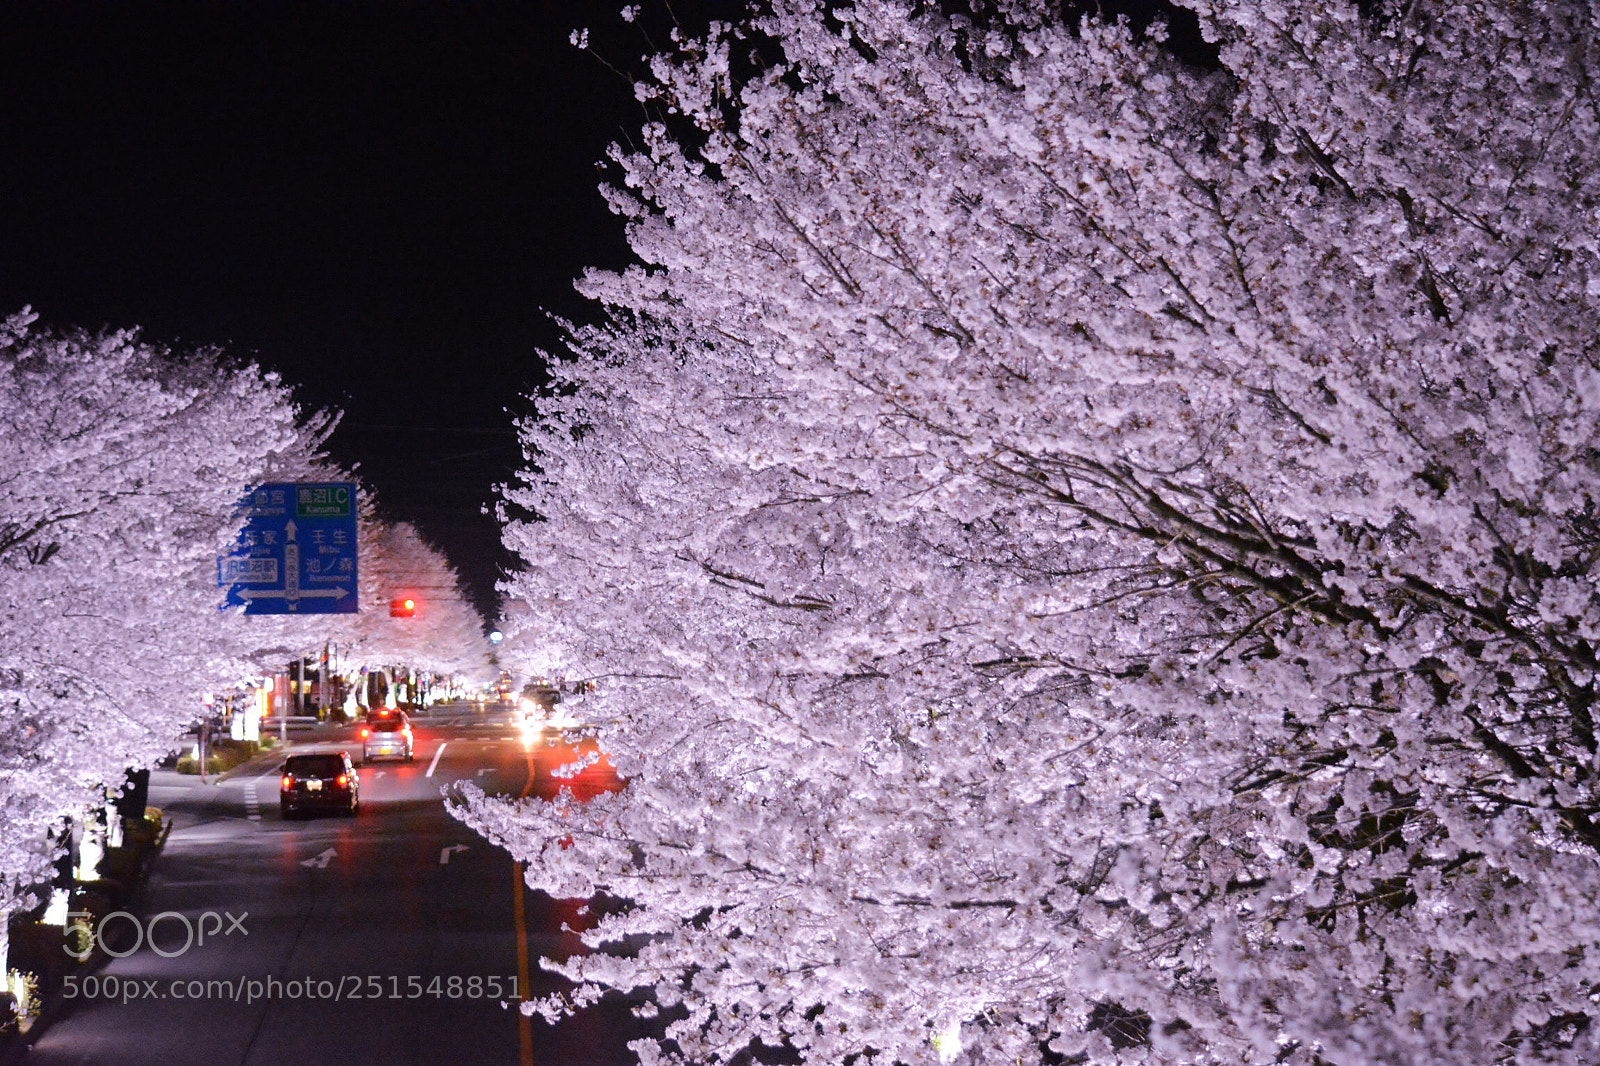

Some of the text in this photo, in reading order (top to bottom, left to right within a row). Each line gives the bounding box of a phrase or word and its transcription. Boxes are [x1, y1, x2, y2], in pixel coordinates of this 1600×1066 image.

[312, 528, 348, 544] 壬生
[318, 545, 340, 554] Mibu
[306, 557, 353, 573] 池ノ森
